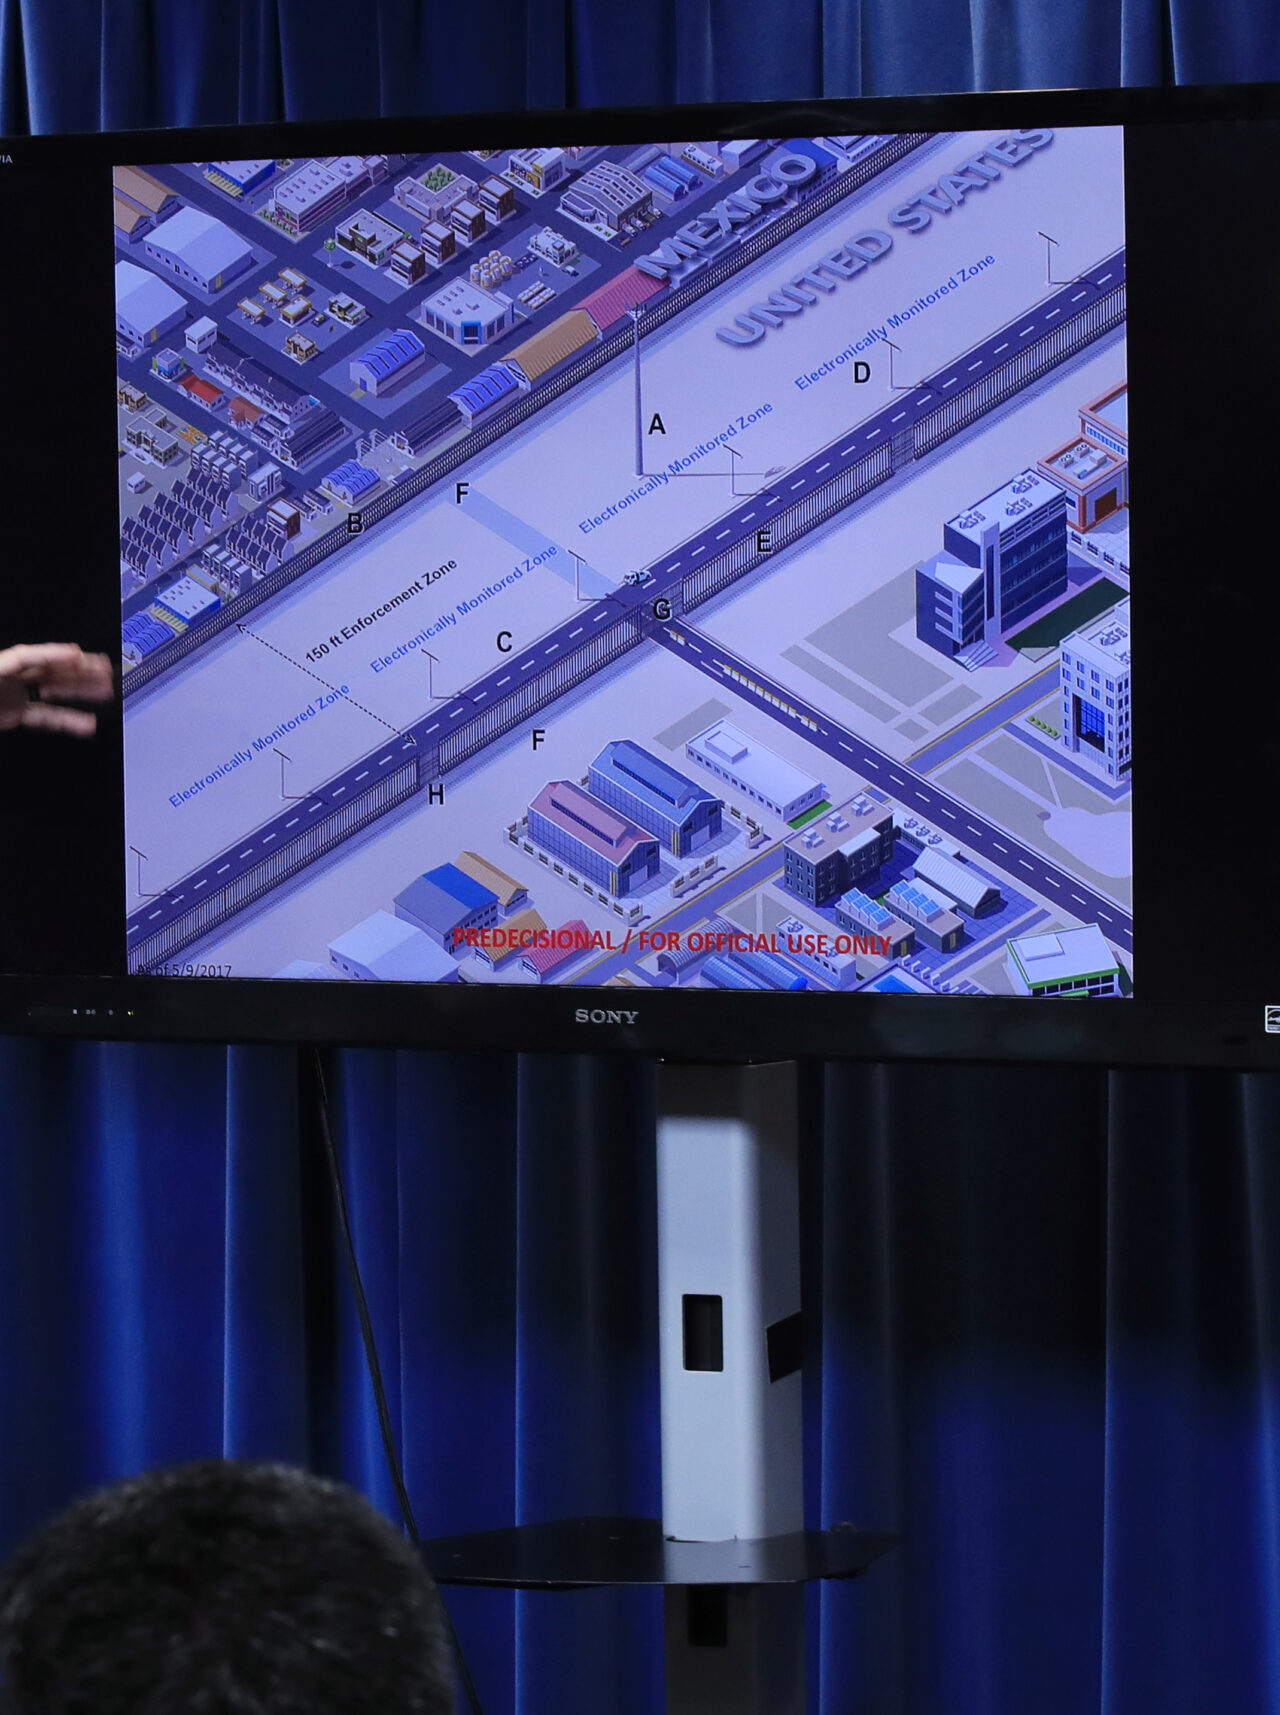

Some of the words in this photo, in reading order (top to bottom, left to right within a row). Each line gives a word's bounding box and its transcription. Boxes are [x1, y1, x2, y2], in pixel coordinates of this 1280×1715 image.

[633, 153, 817, 280] MEXICO
[716, 229, 893, 347] UNITED
[889, 129, 1055, 234] STATES
[794, 326, 888, 391] Electronically
[886, 277, 959, 329] Monitored
[956, 254, 996, 283] Zone
[853, 361, 871, 384] D
[648, 413, 666, 435] A
[578, 471, 670, 534] Electronically
[668, 424, 738, 476] Monitored
[736, 402, 774, 430] Zone
[456, 483, 469, 503] F
[348, 513, 364, 534] B
[757, 530, 771, 554] E
[305, 643, 330, 663] 150
[329, 635, 343, 648] ft
[340, 580, 424, 640] Enforcement
[421, 559, 458, 586] Zone
[370, 612, 458, 673] Electronically
[456, 566, 524, 617] Monitored
[522, 545, 558, 572] Zone
[653, 598, 671, 620] G
[496, 631, 513, 652] C
[169, 748, 254, 808] Electronically
[251, 704, 317, 752] Monitored
[315, 684, 351, 711] Zone
[532, 729, 546, 751] F
[428, 784, 445, 806] H
[453, 927, 616, 950] PREDECISIONAL
[621, 928, 633, 954] /
[639, 931, 680, 951] FOR
[687, 932, 781, 953] OFFICIAL
[787, 934, 828, 954] USE
[834, 934, 892, 956] ONLY
[156, 964, 169, 976] of
[172, 963, 232, 978] 5/9/2017
[575, 1008, 639, 1024] SONY
